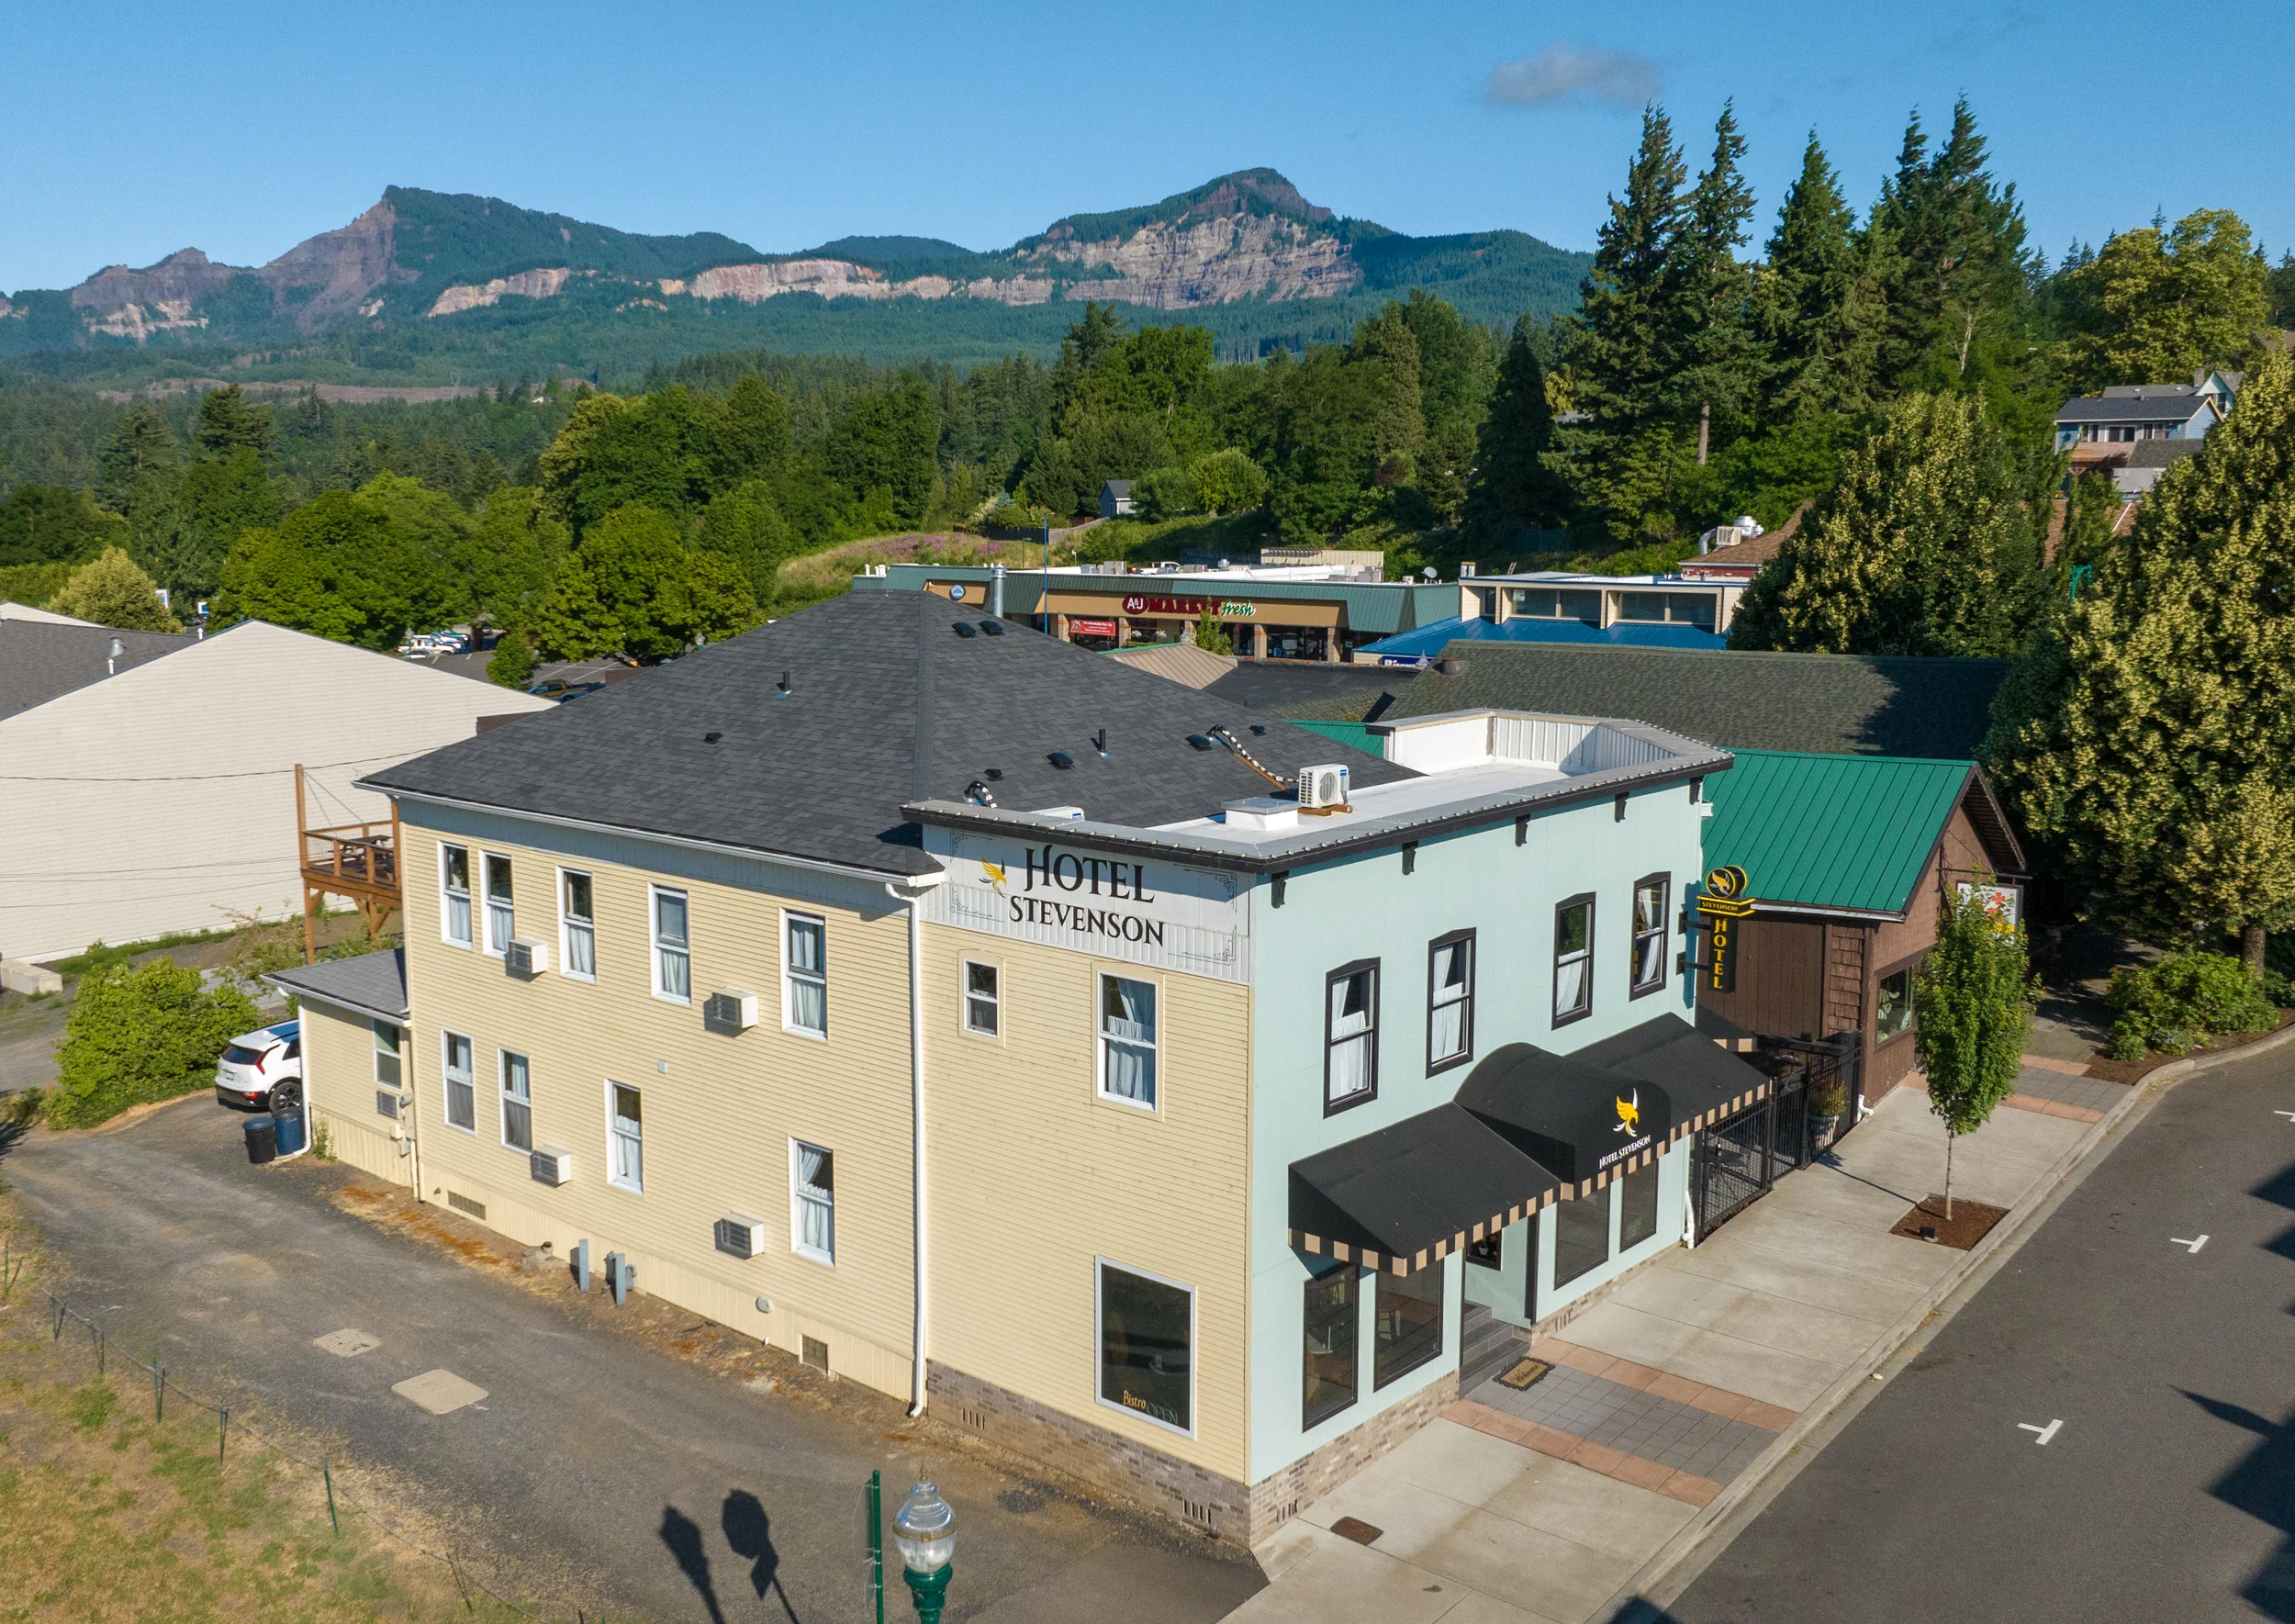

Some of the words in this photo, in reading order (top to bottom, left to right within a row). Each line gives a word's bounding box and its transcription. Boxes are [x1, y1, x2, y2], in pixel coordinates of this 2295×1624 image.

[1126, 597, 1145, 610] A&J
[1222, 599, 1257, 616] fresh
[1024, 844, 1156, 904] HOTEL
[1009, 895, 1165, 947] STEVENSON
[1701, 901, 1738, 913] STEVENSON
[1713, 918, 1728, 989] HOTEL
[1599, 1151, 1618, 1170] HOTEL
[1618, 1134, 1651, 1159] STEVENSON
[1123, 1389, 1147, 1409] Bistro
[1147, 1403, 1179, 1425] OPEN
